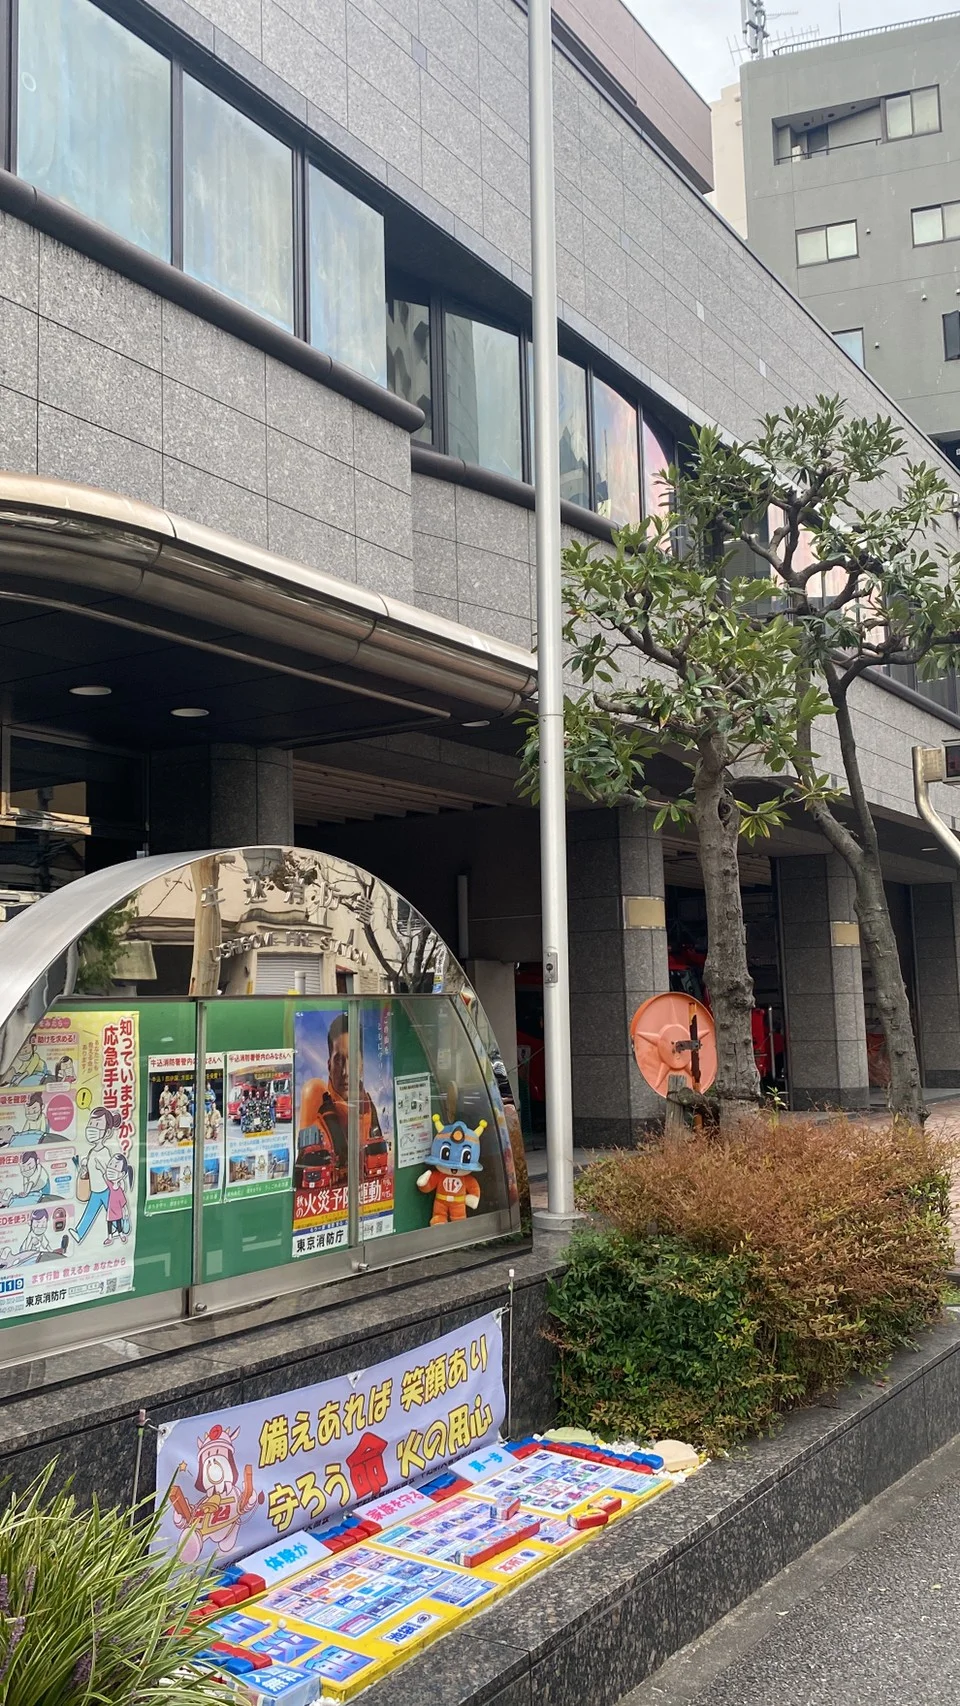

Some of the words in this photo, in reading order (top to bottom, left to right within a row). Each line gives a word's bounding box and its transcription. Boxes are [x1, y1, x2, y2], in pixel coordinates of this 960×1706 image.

[285, 931, 313, 948] FIRE
[104, 1025, 118, 1108] 応急手当
[119, 1019, 133, 1155] 知っていますか?
[296, 1230, 344, 1253] 東京消防庁
[93, 1257, 126, 1271] あなたから
[25, 1289, 67, 1308] 東京消防庁
[259, 1379, 393, 1468] 備えあれば
[400, 1335, 488, 1411] 笑顔あり
[267, 1432, 390, 1533] 守ろう命
[396, 1394, 494, 1478] 火の用心
[366, 1489, 424, 1522] 家族を守る
[264, 1541, 309, 1572] 体験が
